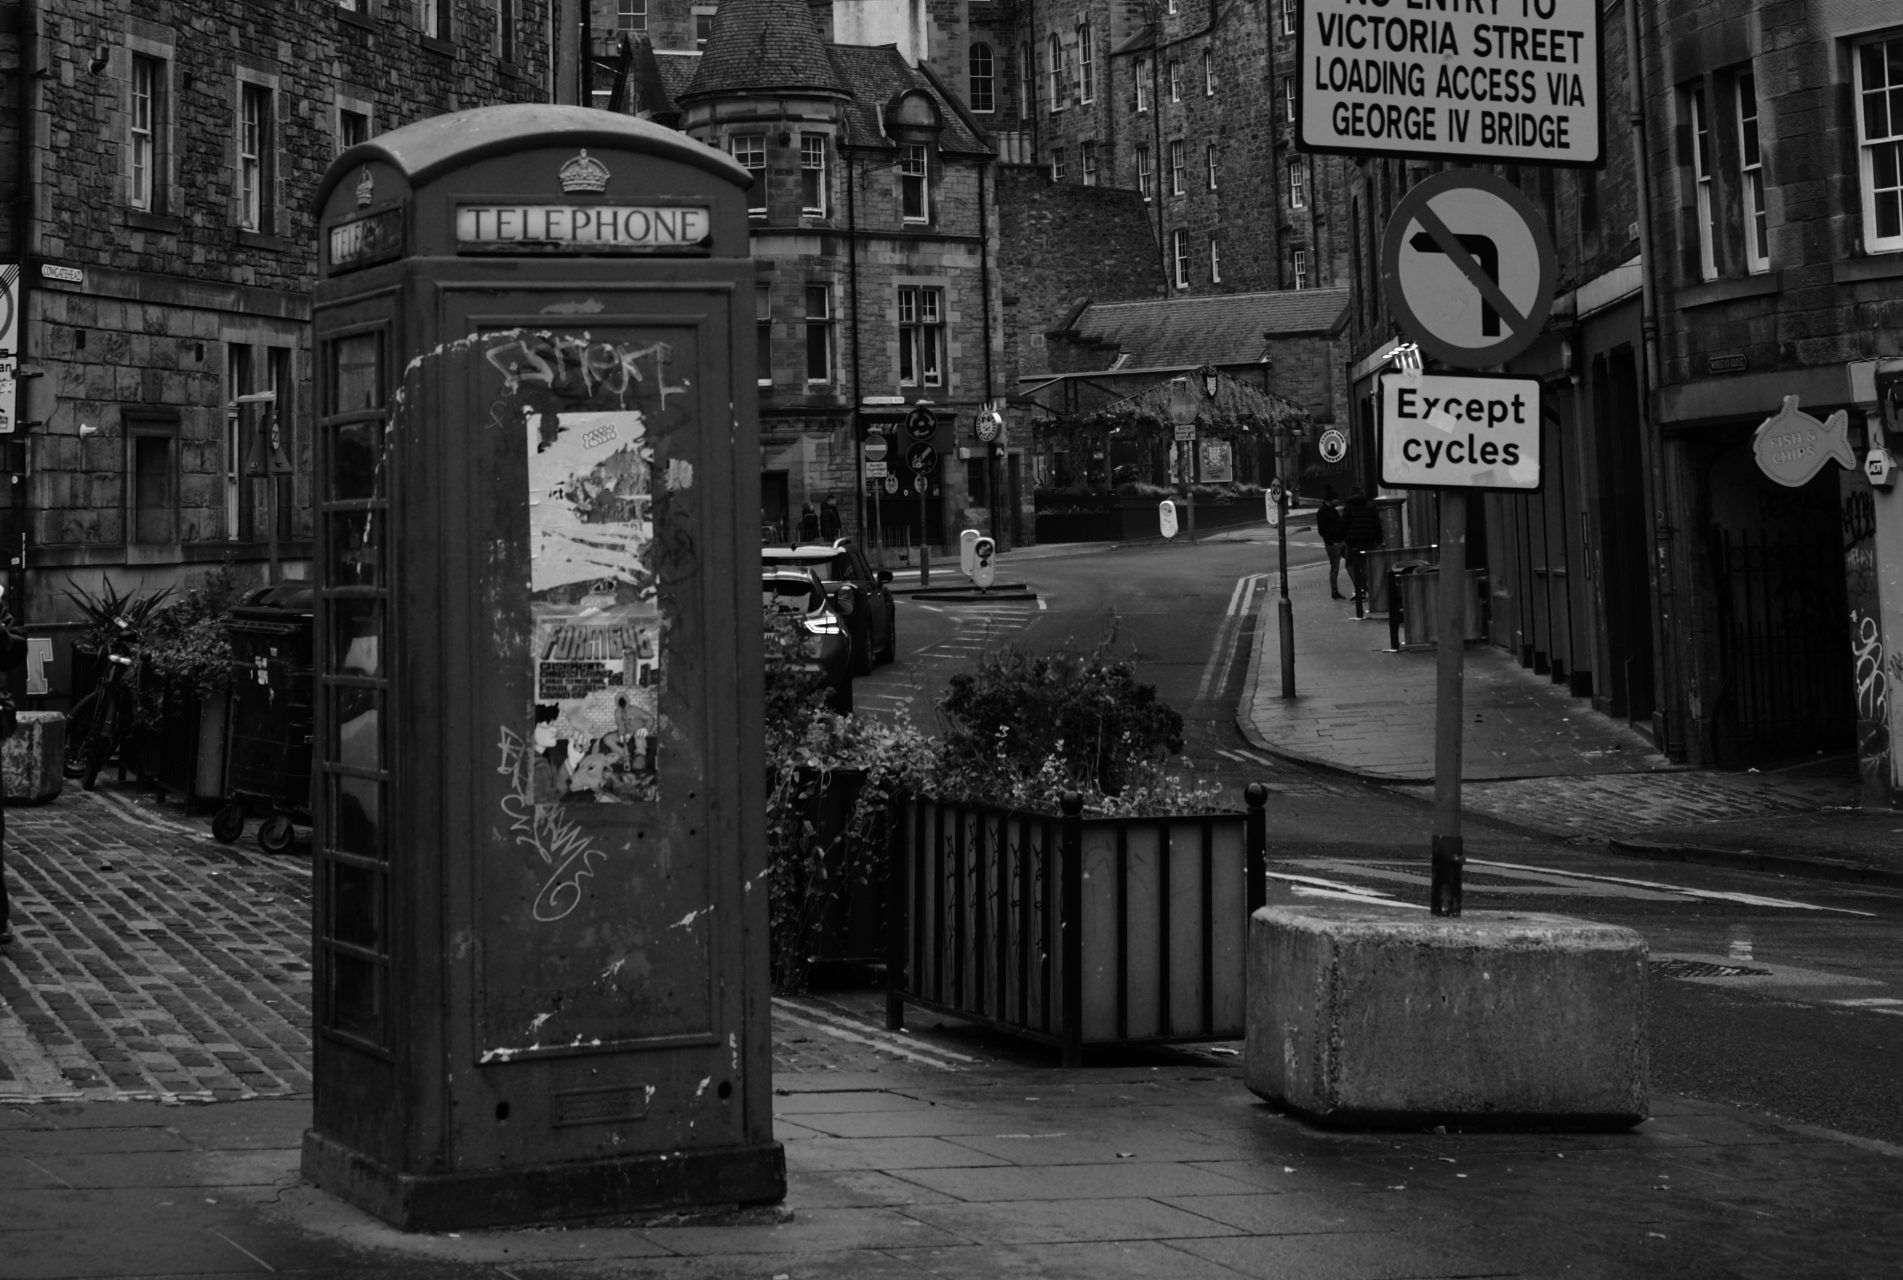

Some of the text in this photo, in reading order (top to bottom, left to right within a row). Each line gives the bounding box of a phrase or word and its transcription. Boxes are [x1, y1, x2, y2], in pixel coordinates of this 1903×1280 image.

[1317, 12, 1584, 63] VICTORIA STREET
[1316, 56, 1585, 107] LOADING ACCESS VIA
[1333, 102, 1570, 149] GEORGE IV BRIDGE
[466, 207, 700, 242] TELEPHONE
[43, 264, 82, 281] COWGATEHEAD
[1398, 388, 1526, 429] Except
[1403, 434, 1520, 468] cycles
[1769, 430, 1817, 449] FISH &
[1772, 445, 1816, 464] CHIPS
[1869, 462, 1883, 474] ADT
